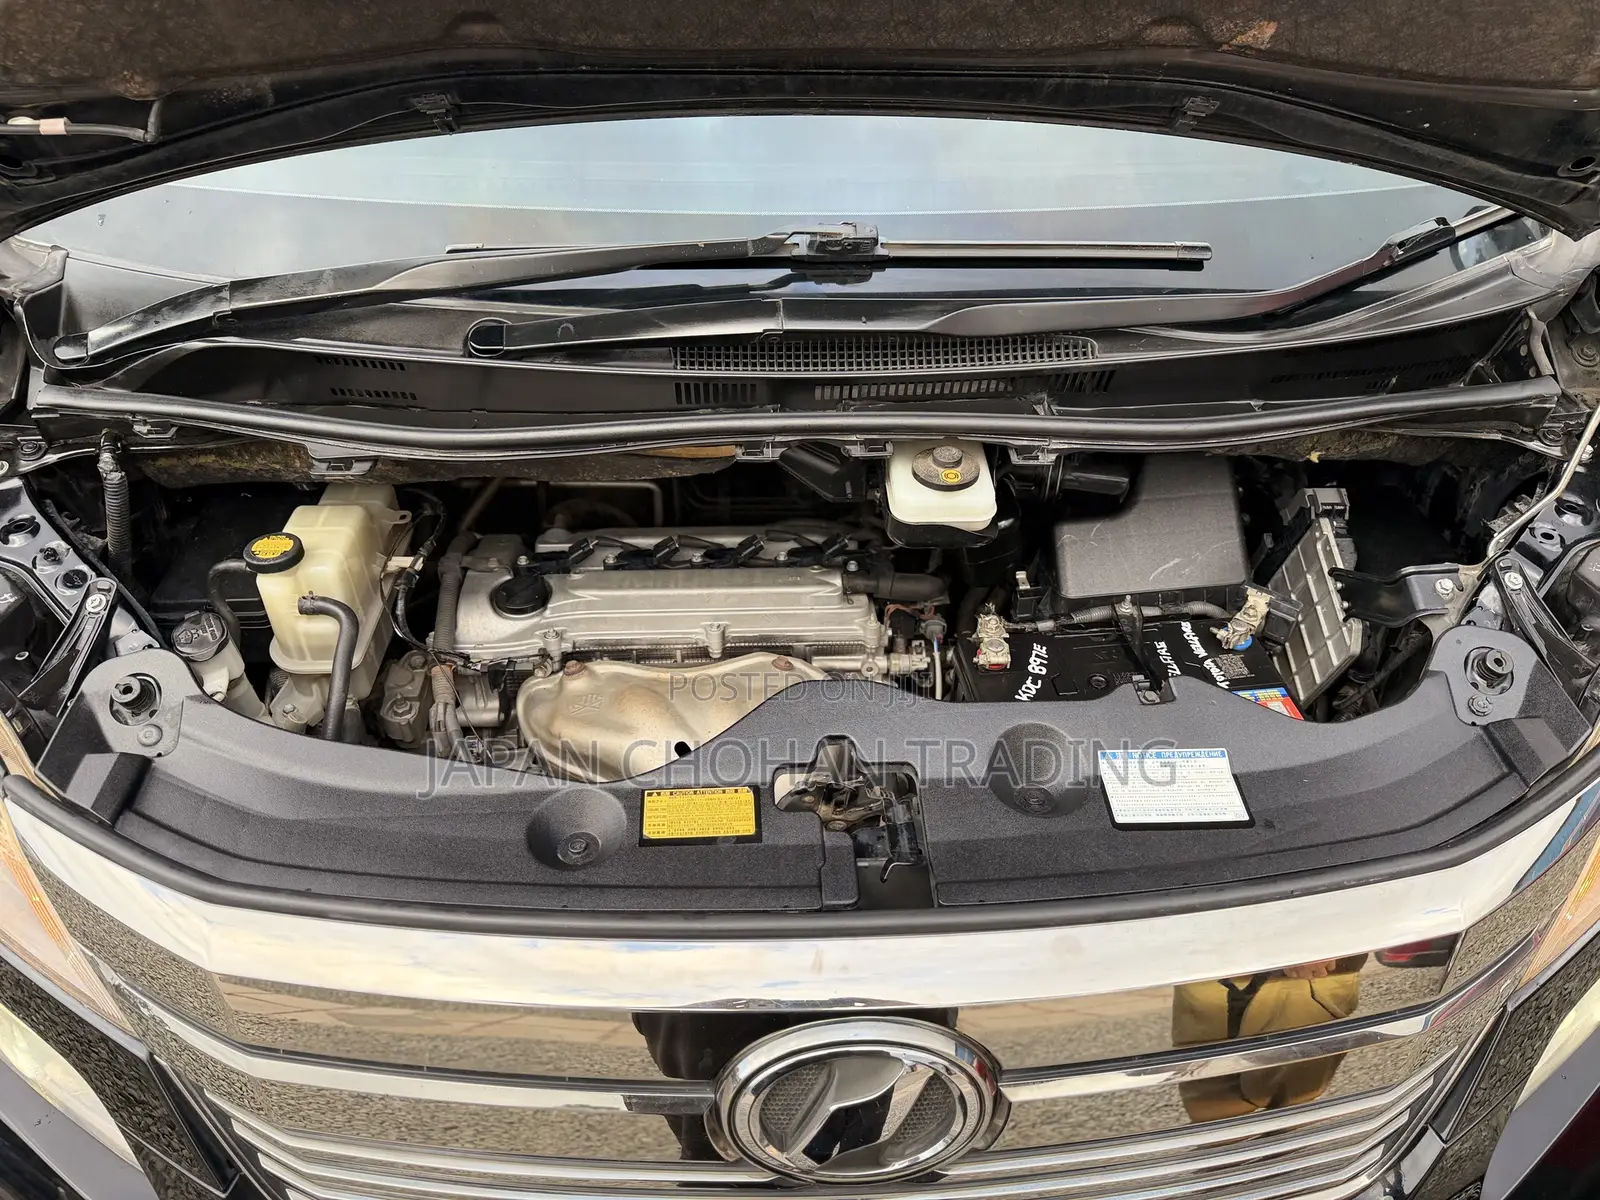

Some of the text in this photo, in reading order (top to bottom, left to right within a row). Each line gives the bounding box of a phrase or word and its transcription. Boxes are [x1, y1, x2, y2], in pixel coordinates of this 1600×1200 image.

[1203, 658, 1231, 689] TOYOTA
[1014, 675, 1042, 701] KDC
[1161, 750, 1223, 759] ПРЕДУПРЕЖДЕНИЕ
